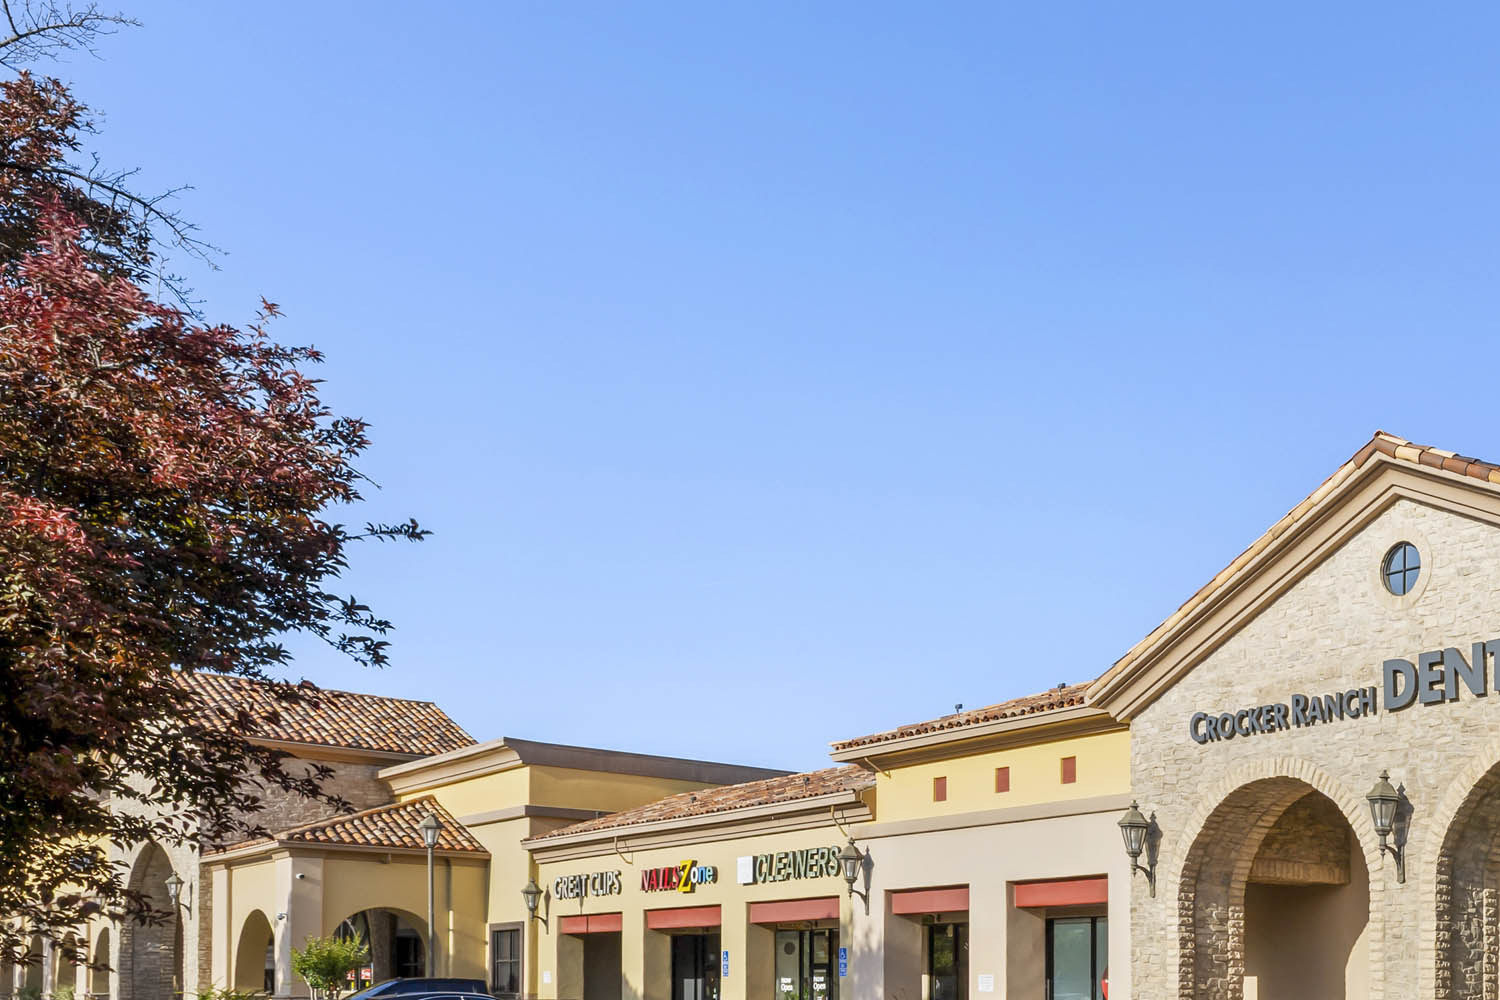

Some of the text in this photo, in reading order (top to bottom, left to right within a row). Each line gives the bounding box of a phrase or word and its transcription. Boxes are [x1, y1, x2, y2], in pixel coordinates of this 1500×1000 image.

[1190, 702, 1290, 745] CROCKER
[1291, 686, 1378, 727] RANCH
[641, 865, 681, 893] NAILS
[755, 845, 842, 884] CLEANERS
[554, 870, 622, 900] GREAT CLIPS
